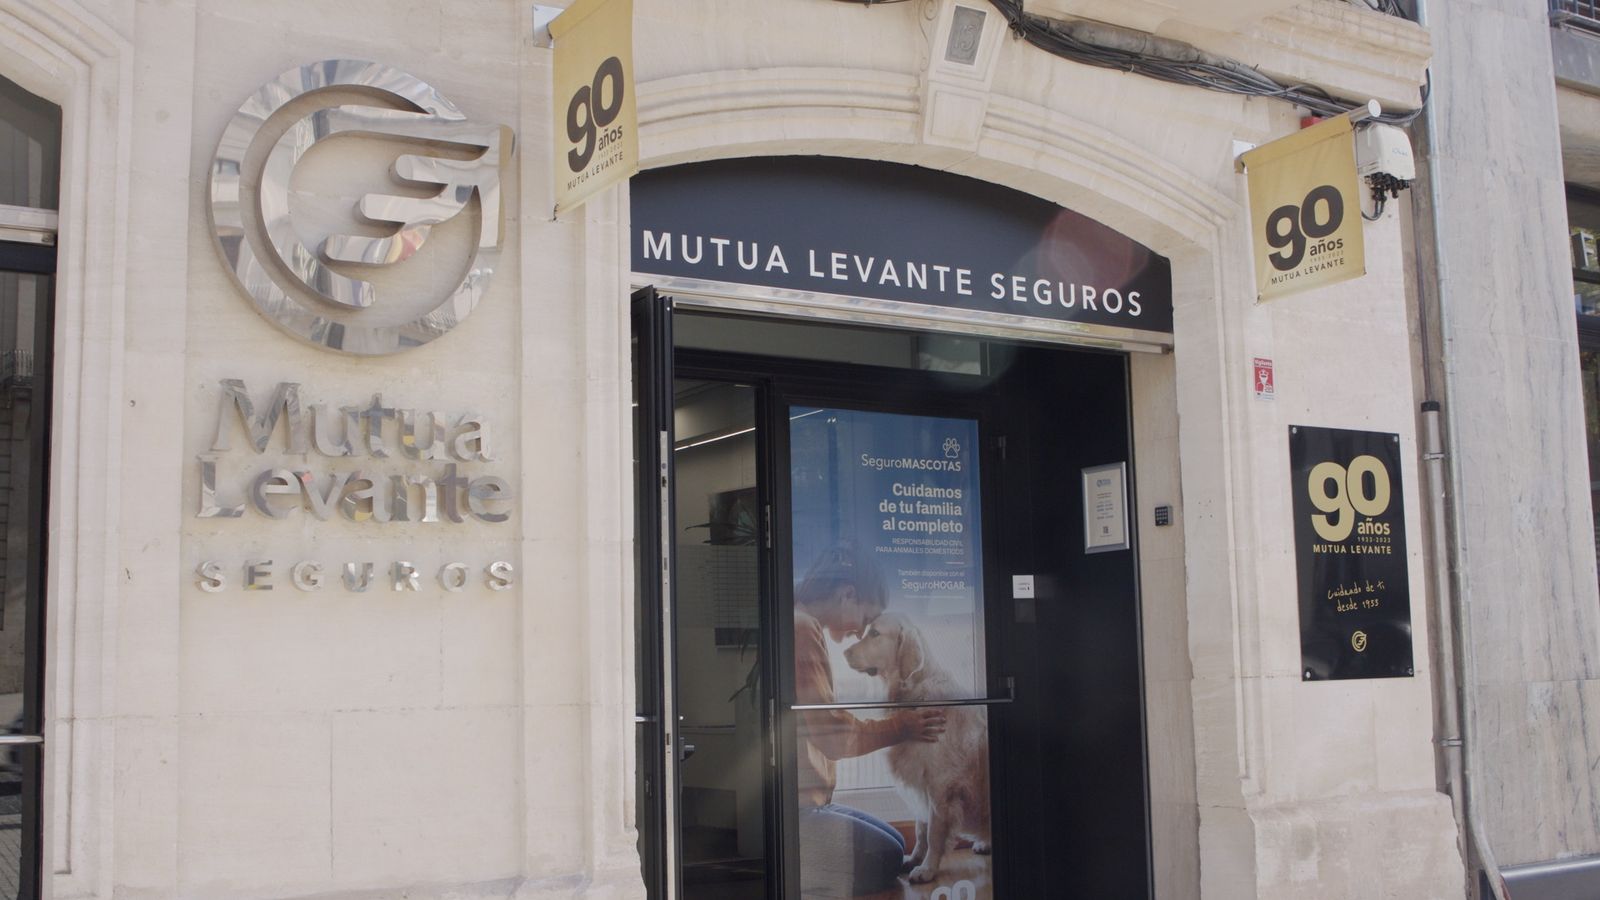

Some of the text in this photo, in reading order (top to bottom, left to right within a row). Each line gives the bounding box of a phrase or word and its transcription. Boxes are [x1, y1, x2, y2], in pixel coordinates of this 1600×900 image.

[566, 56, 625, 173] 90
[598, 125, 624, 152] años
[567, 151, 624, 191] MUTUA LEVANTE
[1265, 184, 1344, 271] 90
[1309, 237, 1344, 257] años
[642, 229, 1143, 317] MUTUA LEVANTE SEGUROS
[1271, 257, 1345, 286] MUTUA LEVANTE
[209, 378, 496, 462] Mutua
[861, 453, 962, 472] SeguroMASCOTAS
[195, 454, 513, 523] Levante
[892, 482, 962, 499] Cuidamos
[1308, 454, 1391, 542] 90
[879, 499, 963, 516] de tu familia
[882, 517, 964, 535] al completo
[1357, 517, 1391, 535] años
[1313, 544, 1392, 555] MUTUA LEVANTE
[194, 559, 514, 593] SEGUROS
[902, 579, 966, 592] SeguroHOGAR
[1365, 580, 1375, 592] de
[1376, 580, 1385, 590] ti
[1337, 597, 1359, 612] desde
